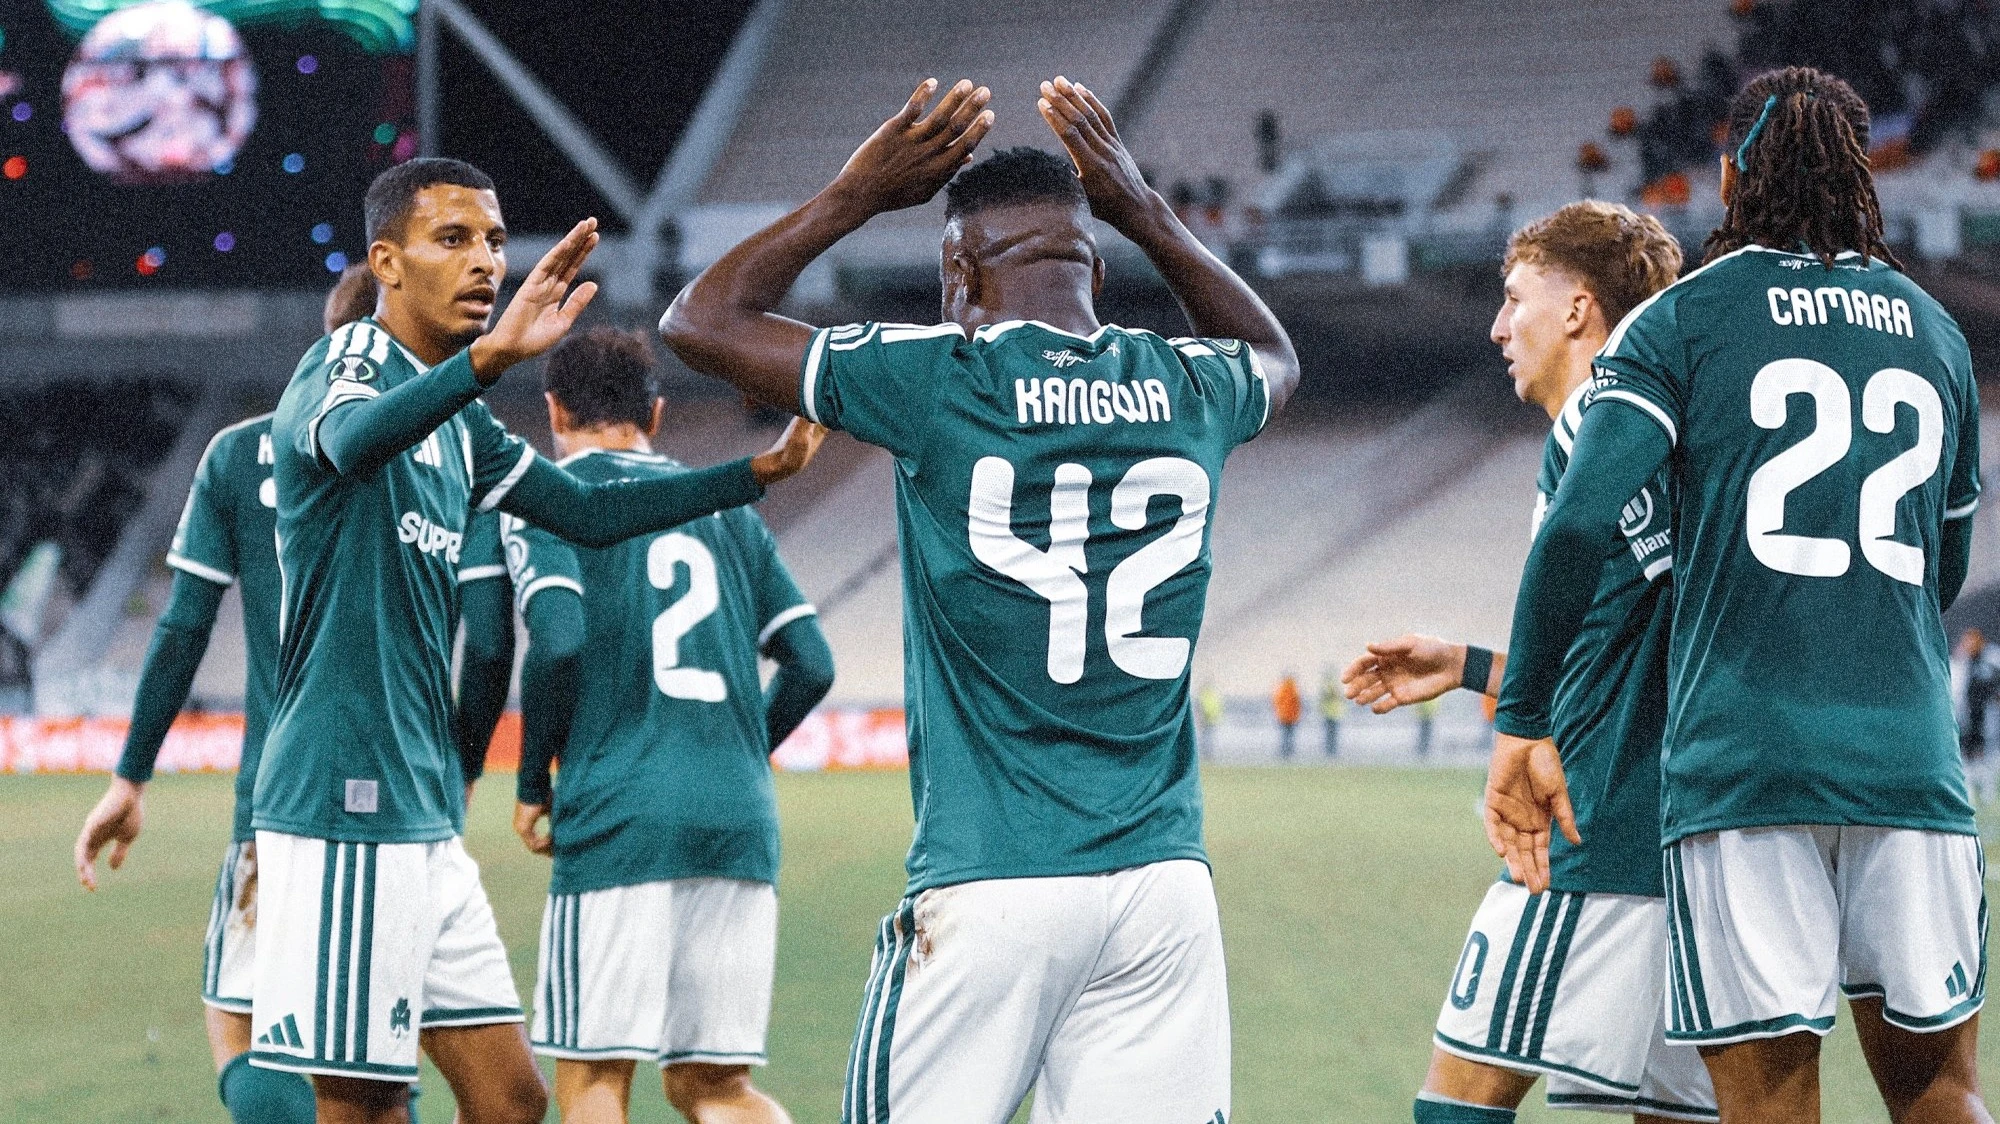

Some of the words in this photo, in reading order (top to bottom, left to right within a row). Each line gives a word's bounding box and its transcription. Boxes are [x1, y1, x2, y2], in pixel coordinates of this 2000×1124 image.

[1767, 287, 1913, 339] CAMARA
[1015, 377, 1171, 425] KANGWA
[1747, 358, 1944, 587] 22
[647, 531, 727, 702] 2
[968, 456, 1210, 684] 42
